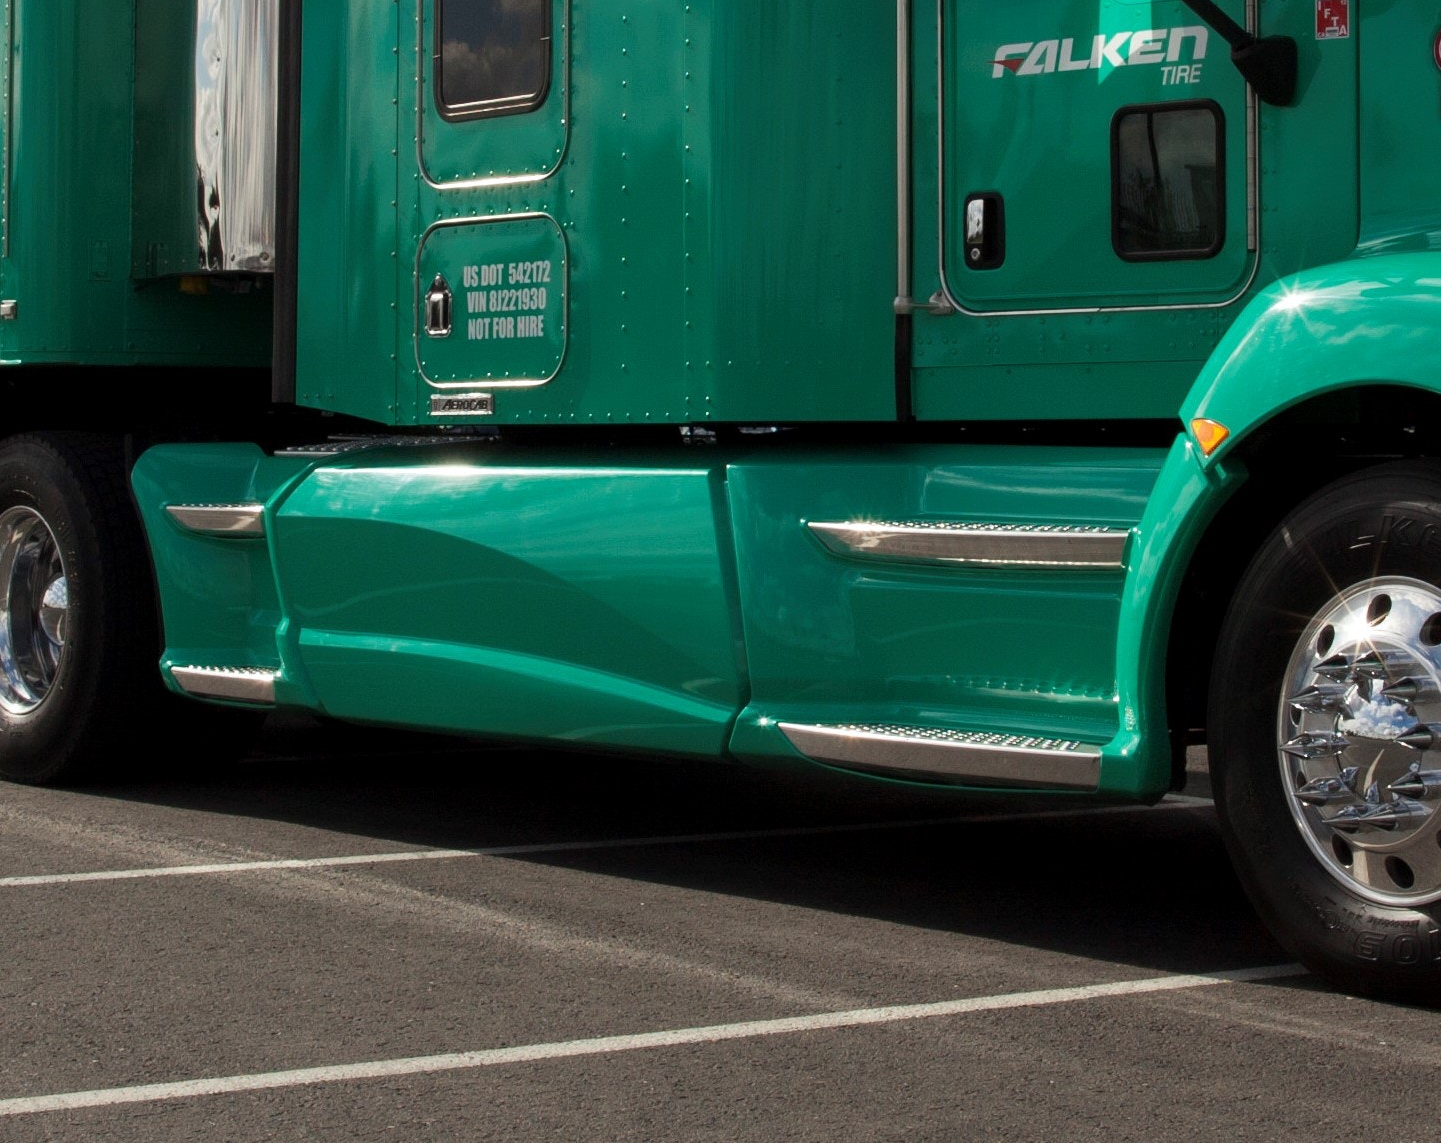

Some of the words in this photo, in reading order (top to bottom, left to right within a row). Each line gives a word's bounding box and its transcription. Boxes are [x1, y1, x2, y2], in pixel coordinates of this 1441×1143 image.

[990, 25, 1209, 78] FALKEN
[1160, 63, 1202, 86] TIRE
[463, 265, 479, 288] US
[481, 263, 504, 286] DOT
[508, 260, 551, 285] 542172
[467, 291, 487, 313] VIN
[489, 287, 547, 312] 8J221930
[468, 318, 490, 340] NOT
[492, 317, 514, 339] FOR
[516, 315, 544, 338] HIRE
